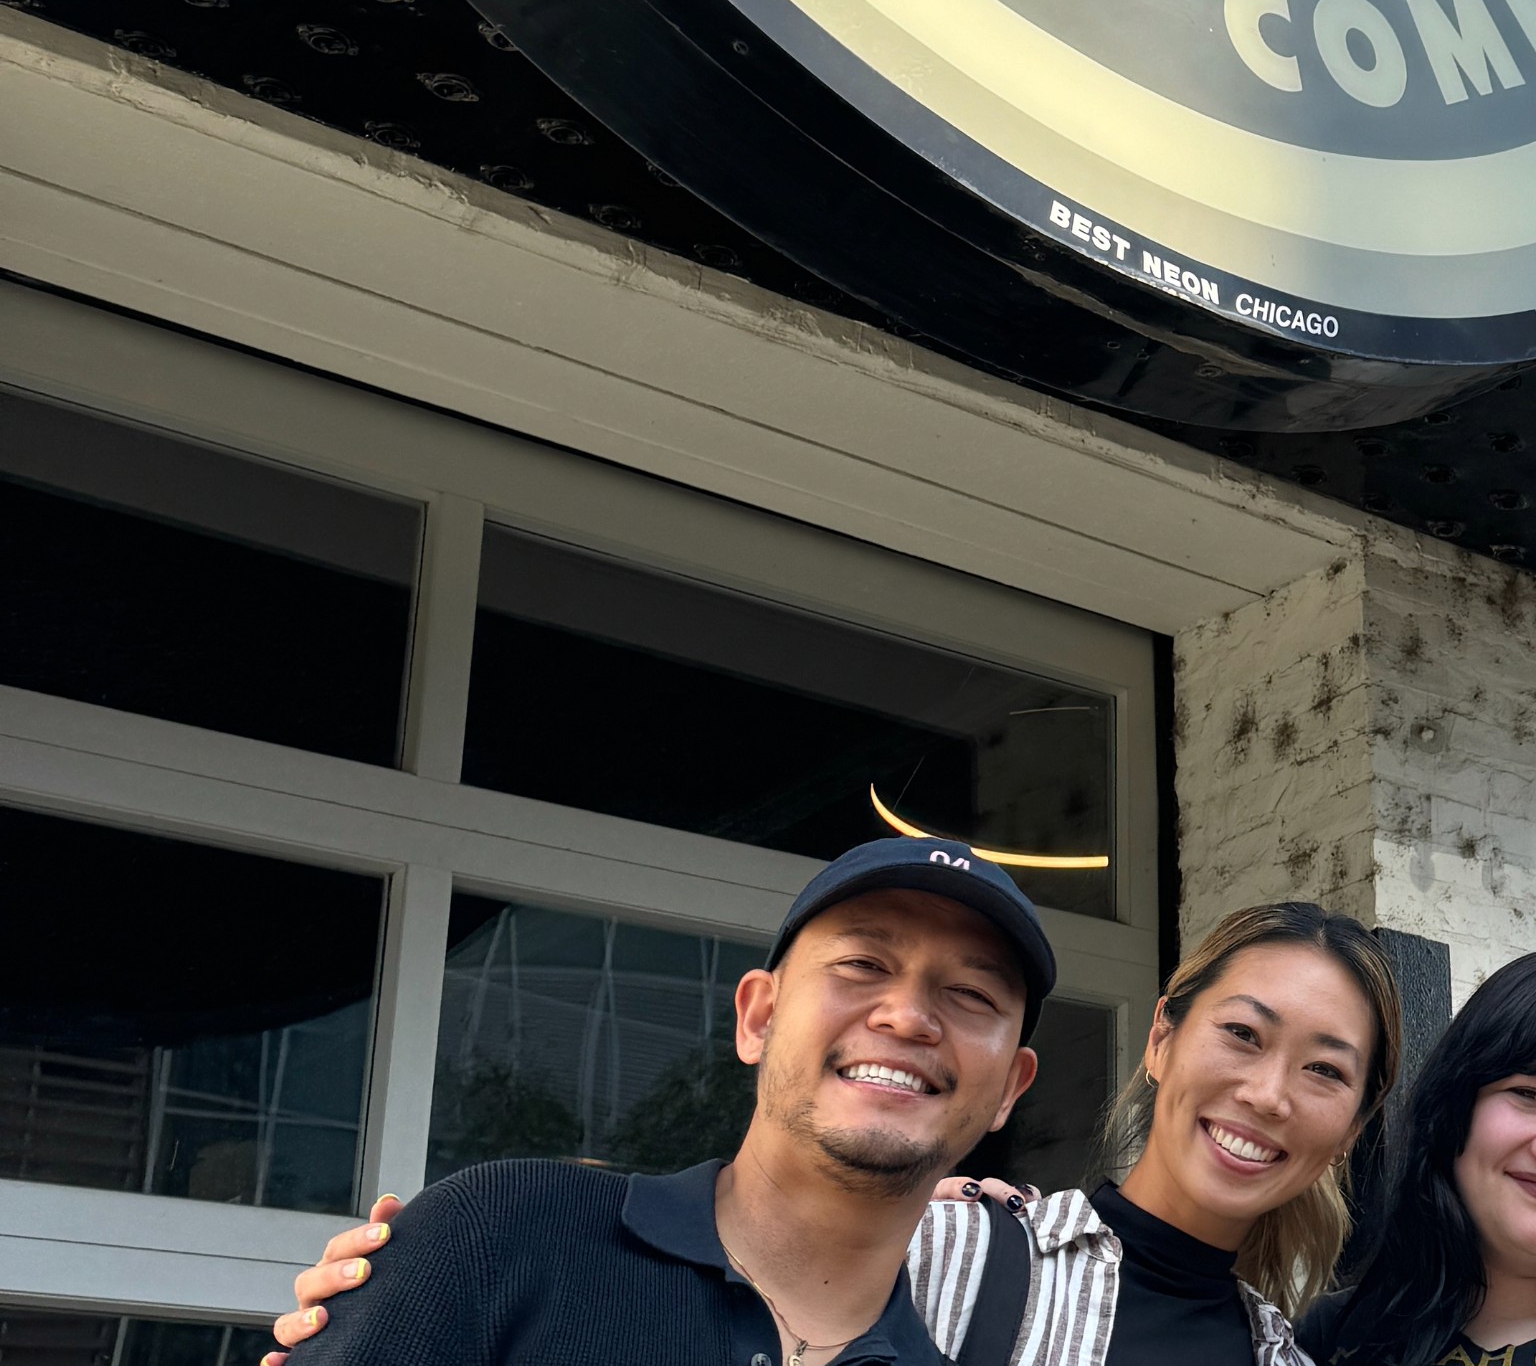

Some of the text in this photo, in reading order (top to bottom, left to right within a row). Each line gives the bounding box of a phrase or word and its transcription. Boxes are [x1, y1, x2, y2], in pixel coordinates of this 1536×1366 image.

[1049, 200, 1339, 338] BEST NEON CHICAGO
